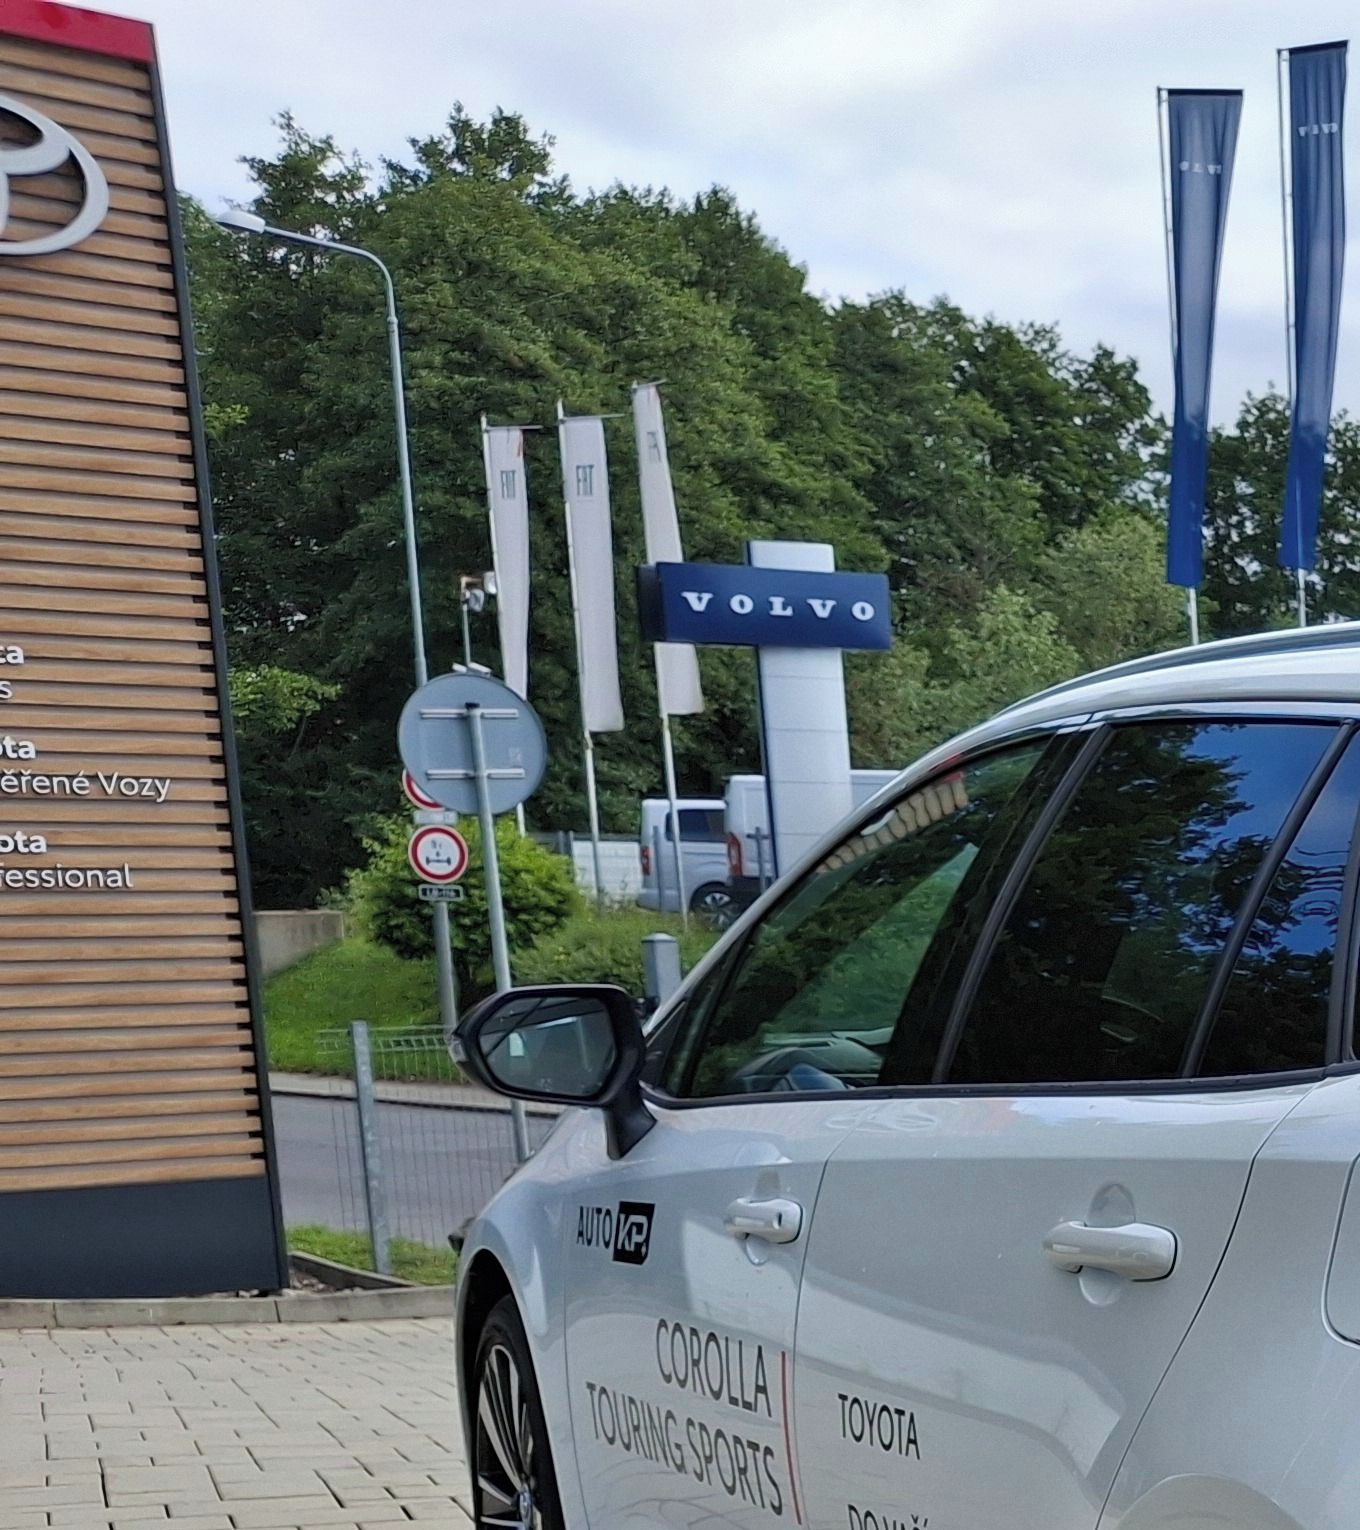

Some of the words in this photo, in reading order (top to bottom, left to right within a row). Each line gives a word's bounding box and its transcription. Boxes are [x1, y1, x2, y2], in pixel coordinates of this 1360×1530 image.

[681, 591, 875, 621] VOLVO
[98, 772, 170, 803] Vozy
[576, 1205, 613, 1249] AUTO
[656, 1319, 772, 1417] COROLLA
[586, 1381, 687, 1474] TOURING
[686, 1421, 783, 1517] SPORTS
[837, 1393, 920, 1460] TOYOTA
